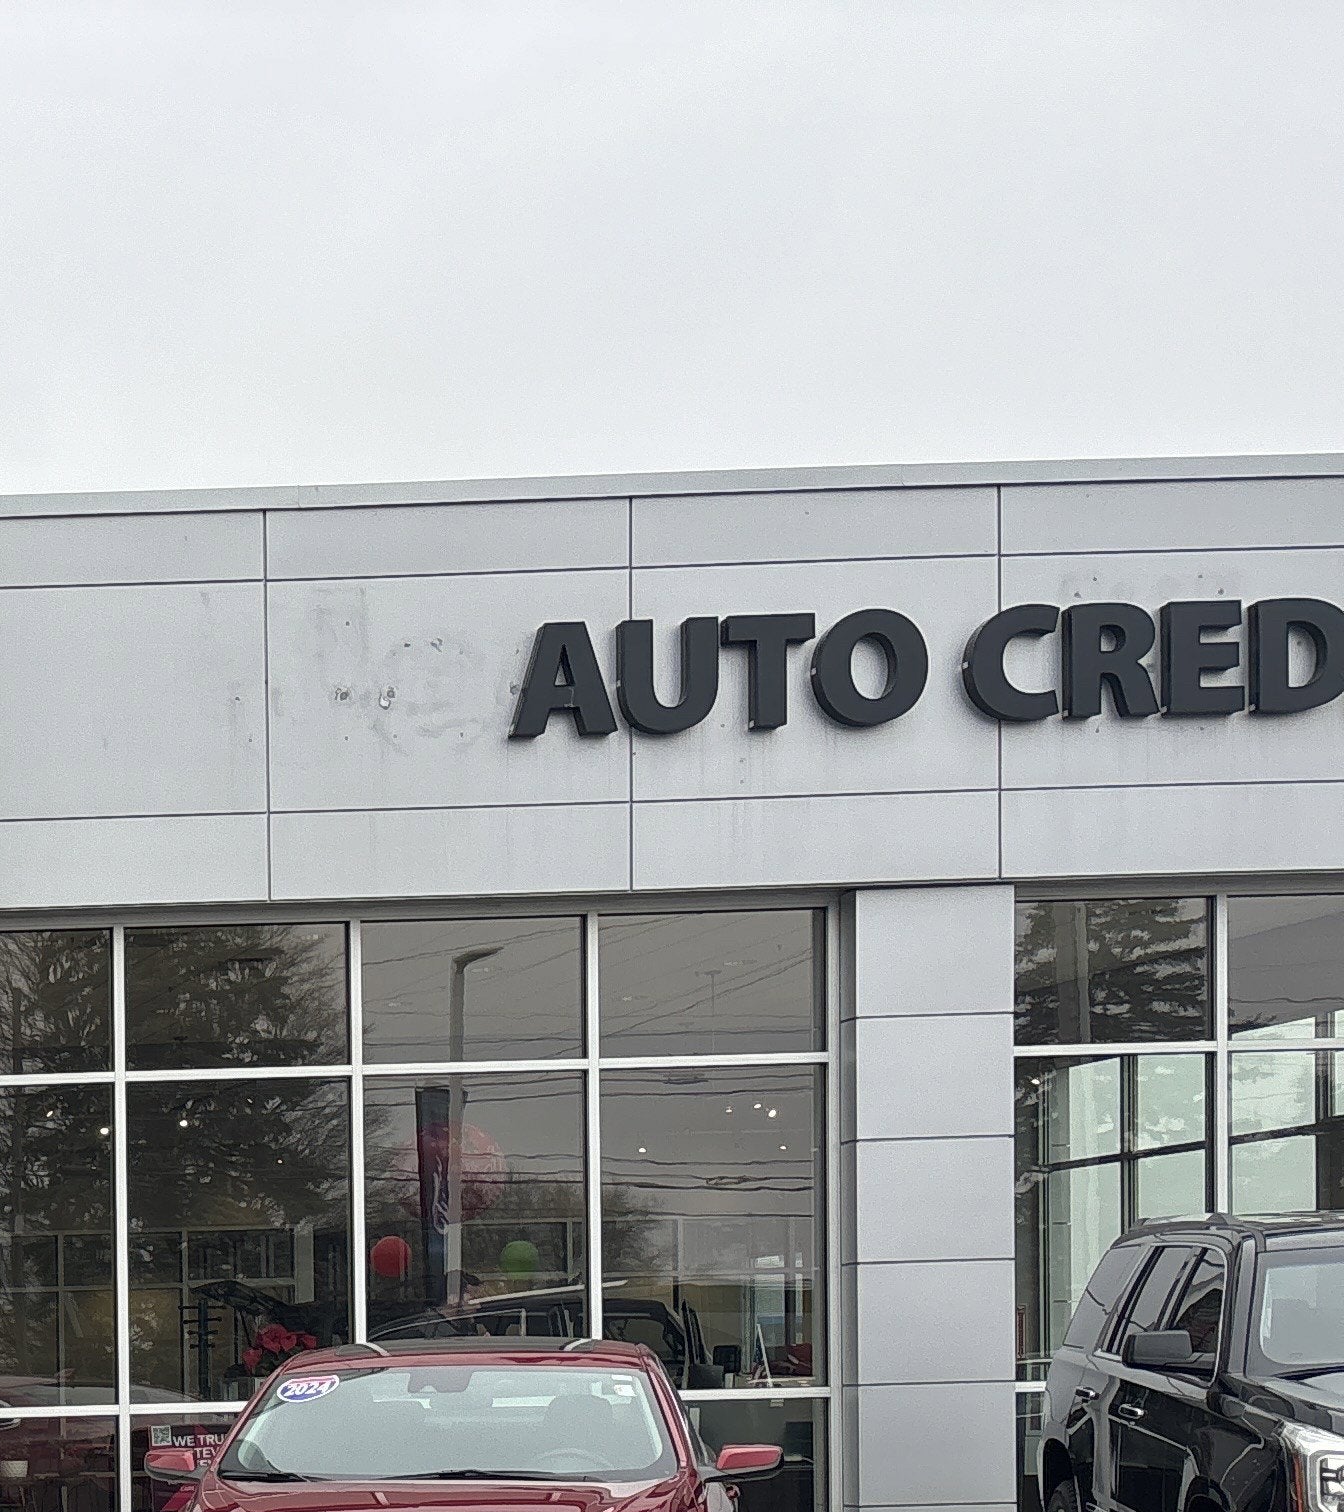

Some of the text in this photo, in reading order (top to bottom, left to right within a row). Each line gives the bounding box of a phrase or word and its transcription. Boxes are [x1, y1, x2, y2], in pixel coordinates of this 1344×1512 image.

[510, 597, 1344, 739] AUTO CRED
[283, 1379, 332, 1397] 2024
[172, 1432, 227, 1447] WE TRU
